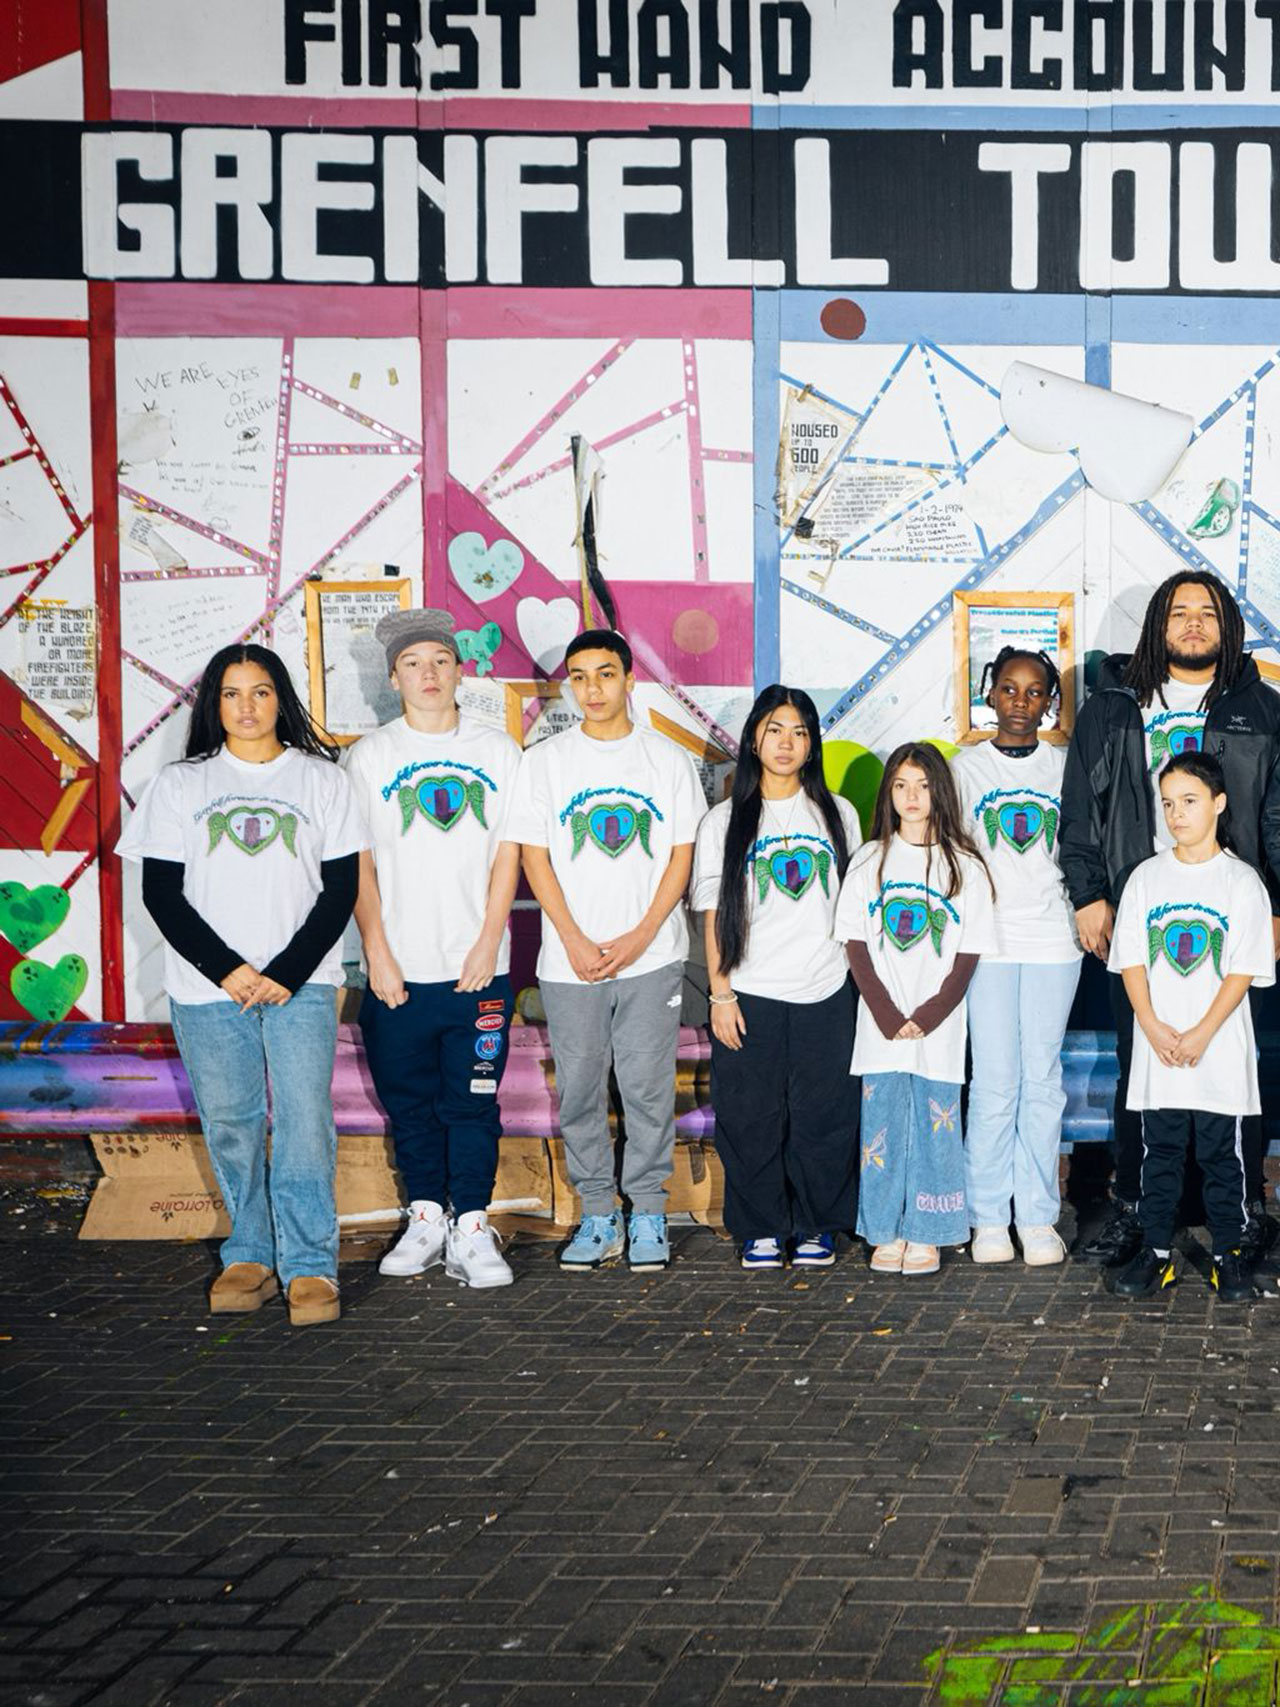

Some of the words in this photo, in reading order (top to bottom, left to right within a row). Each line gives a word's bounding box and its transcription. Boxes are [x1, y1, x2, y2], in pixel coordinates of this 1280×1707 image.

[285, 0, 536, 88] FIRST
[578, 0, 812, 94] HAND
[81, 128, 889, 287] GRENFELL
[135, 371, 172, 393] WE
[180, 360, 214, 384] ARE
[791, 423, 838, 438] HOUSED
[18, 621, 30, 634] OF
[37, 621, 55, 634] THE
[39, 635, 46, 647] A
[48, 648, 61, 660] OR
[66, 648, 93, 661] MORE
[31, 675, 59, 687] WERE
[28, 688, 46, 700] THE
[150, 1199, 211, 1216] Lorraine
